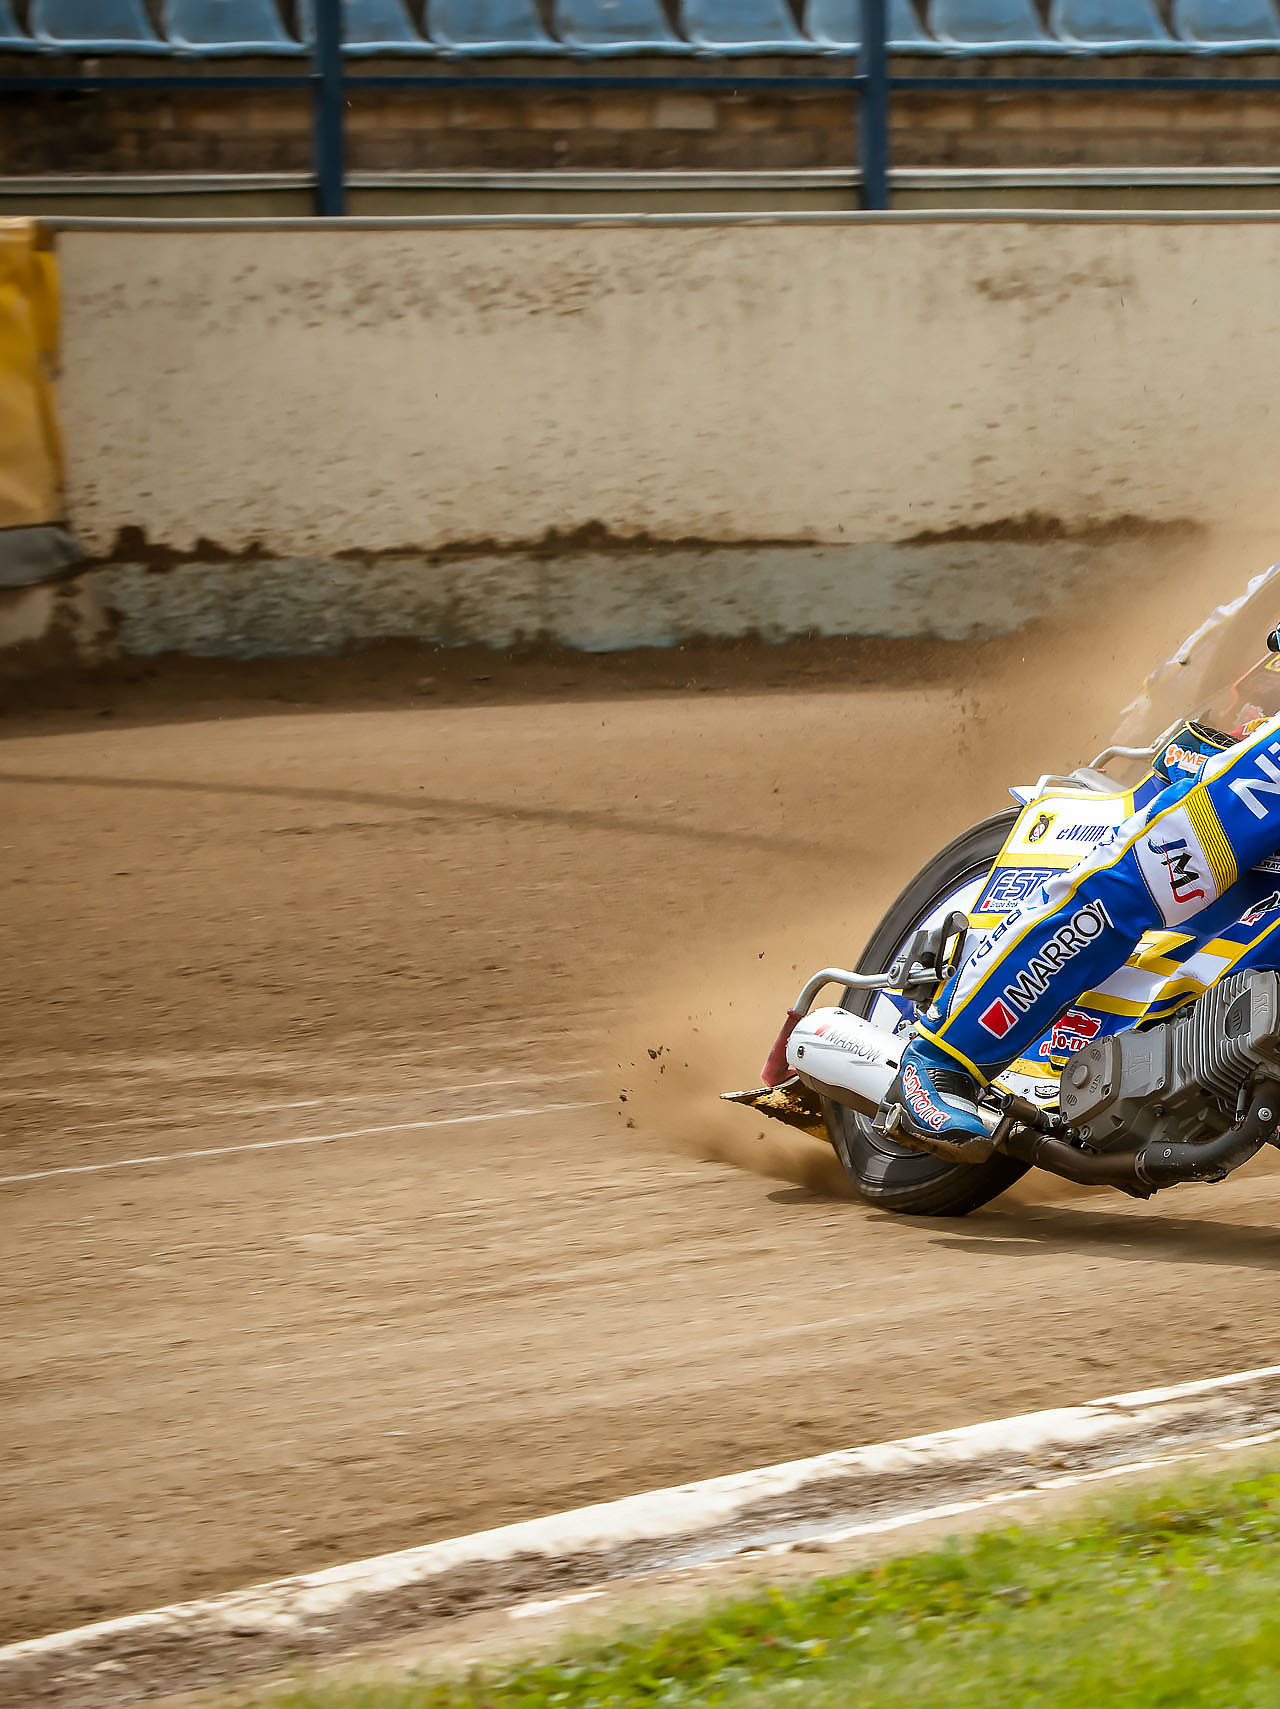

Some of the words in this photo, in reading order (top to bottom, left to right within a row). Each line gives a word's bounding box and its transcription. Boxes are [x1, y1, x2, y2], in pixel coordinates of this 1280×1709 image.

[990, 871, 1050, 900] FST
[1147, 838, 1205, 904] JMS
[825, 1031, 881, 1062] MARROW
[903, 1064, 951, 1130] daytona
